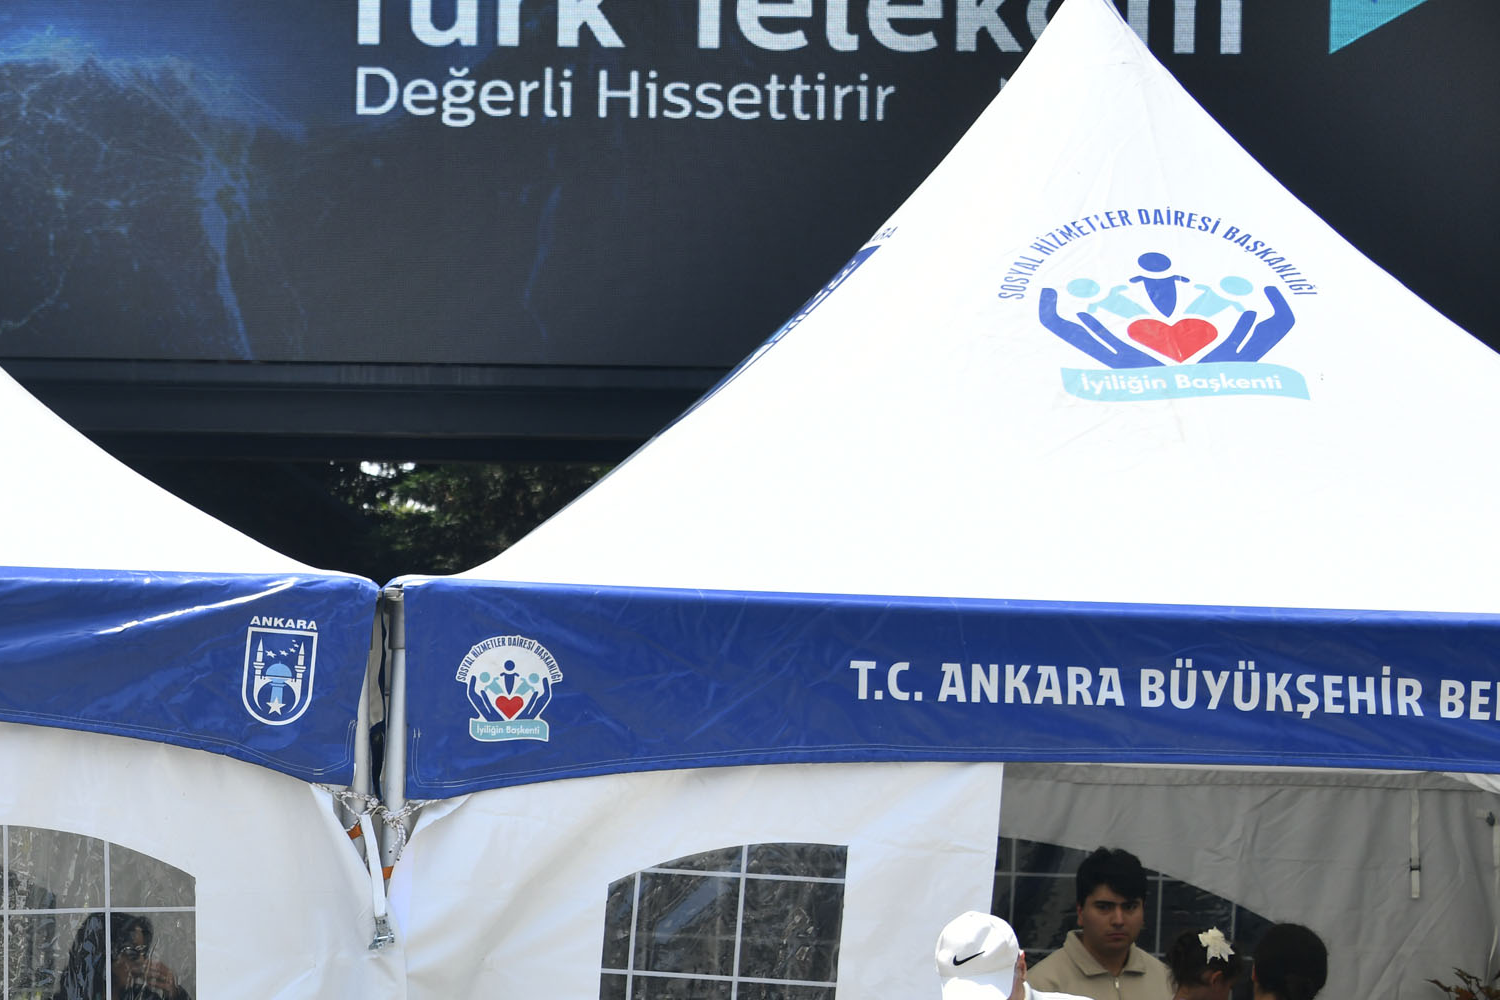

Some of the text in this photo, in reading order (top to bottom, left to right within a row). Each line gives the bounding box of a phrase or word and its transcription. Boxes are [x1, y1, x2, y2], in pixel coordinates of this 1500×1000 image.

[356, 66, 896, 127] Değerli Hissettirir
[998, 205, 1318, 300] SOSYAL HİZMETLER DAİRESİ BAŞKANLIĞI
[1080, 371, 1283, 394] İyiliğin Başkenti
[250, 615, 318, 631] ANKARA
[457, 636, 562, 682] SOSYAL HİZMETLER DAİRESİ BAŞKANLIĞI
[850, 658, 1500, 721] T.C. ANKARA BÜYÜKŞEHİR BE
[476, 725, 541, 736] İyiliğin Başkenti
